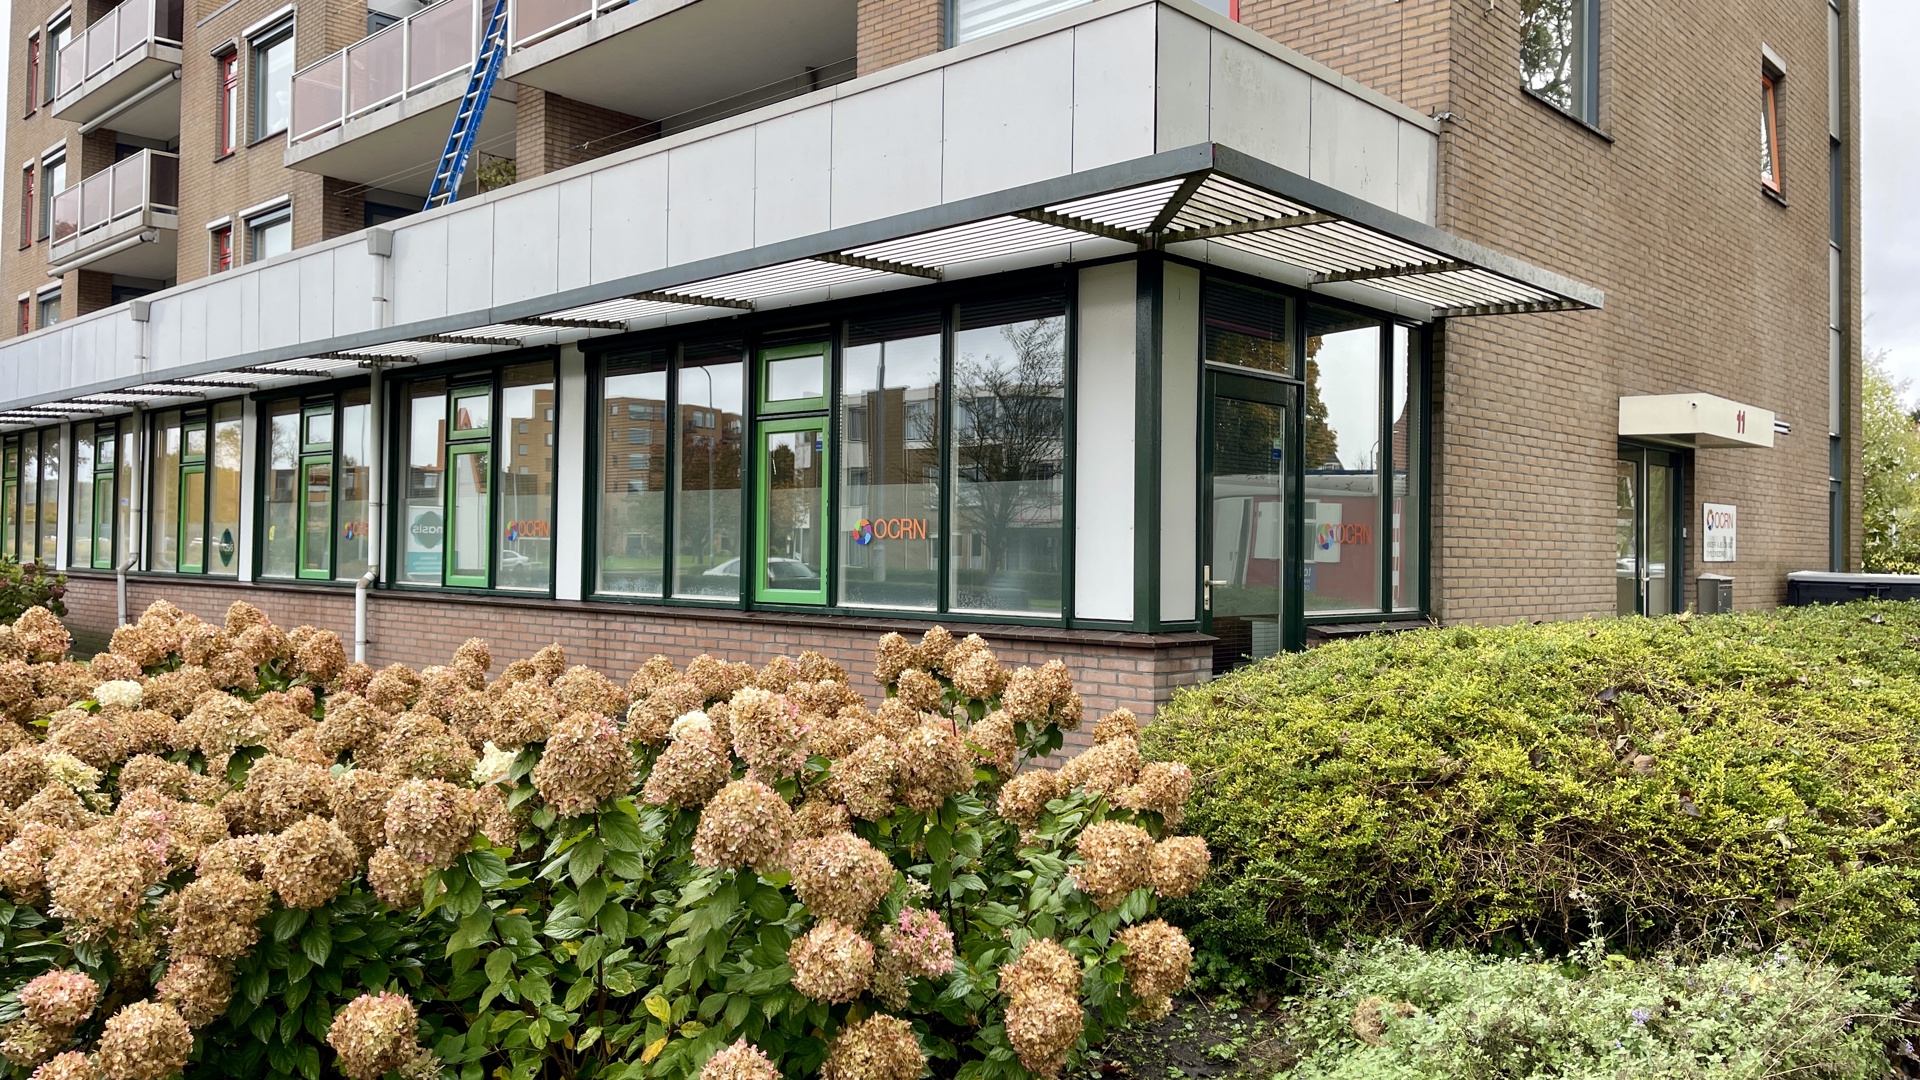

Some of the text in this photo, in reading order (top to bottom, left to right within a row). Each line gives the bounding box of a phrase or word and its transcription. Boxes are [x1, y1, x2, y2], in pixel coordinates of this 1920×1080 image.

[1737, 410, 1745, 434] 11
[518, 520, 549, 536] OCRN
[873, 518, 926, 540] OCRN
[1715, 512, 1734, 529] OCRN
[1335, 523, 1372, 545] OCRN
